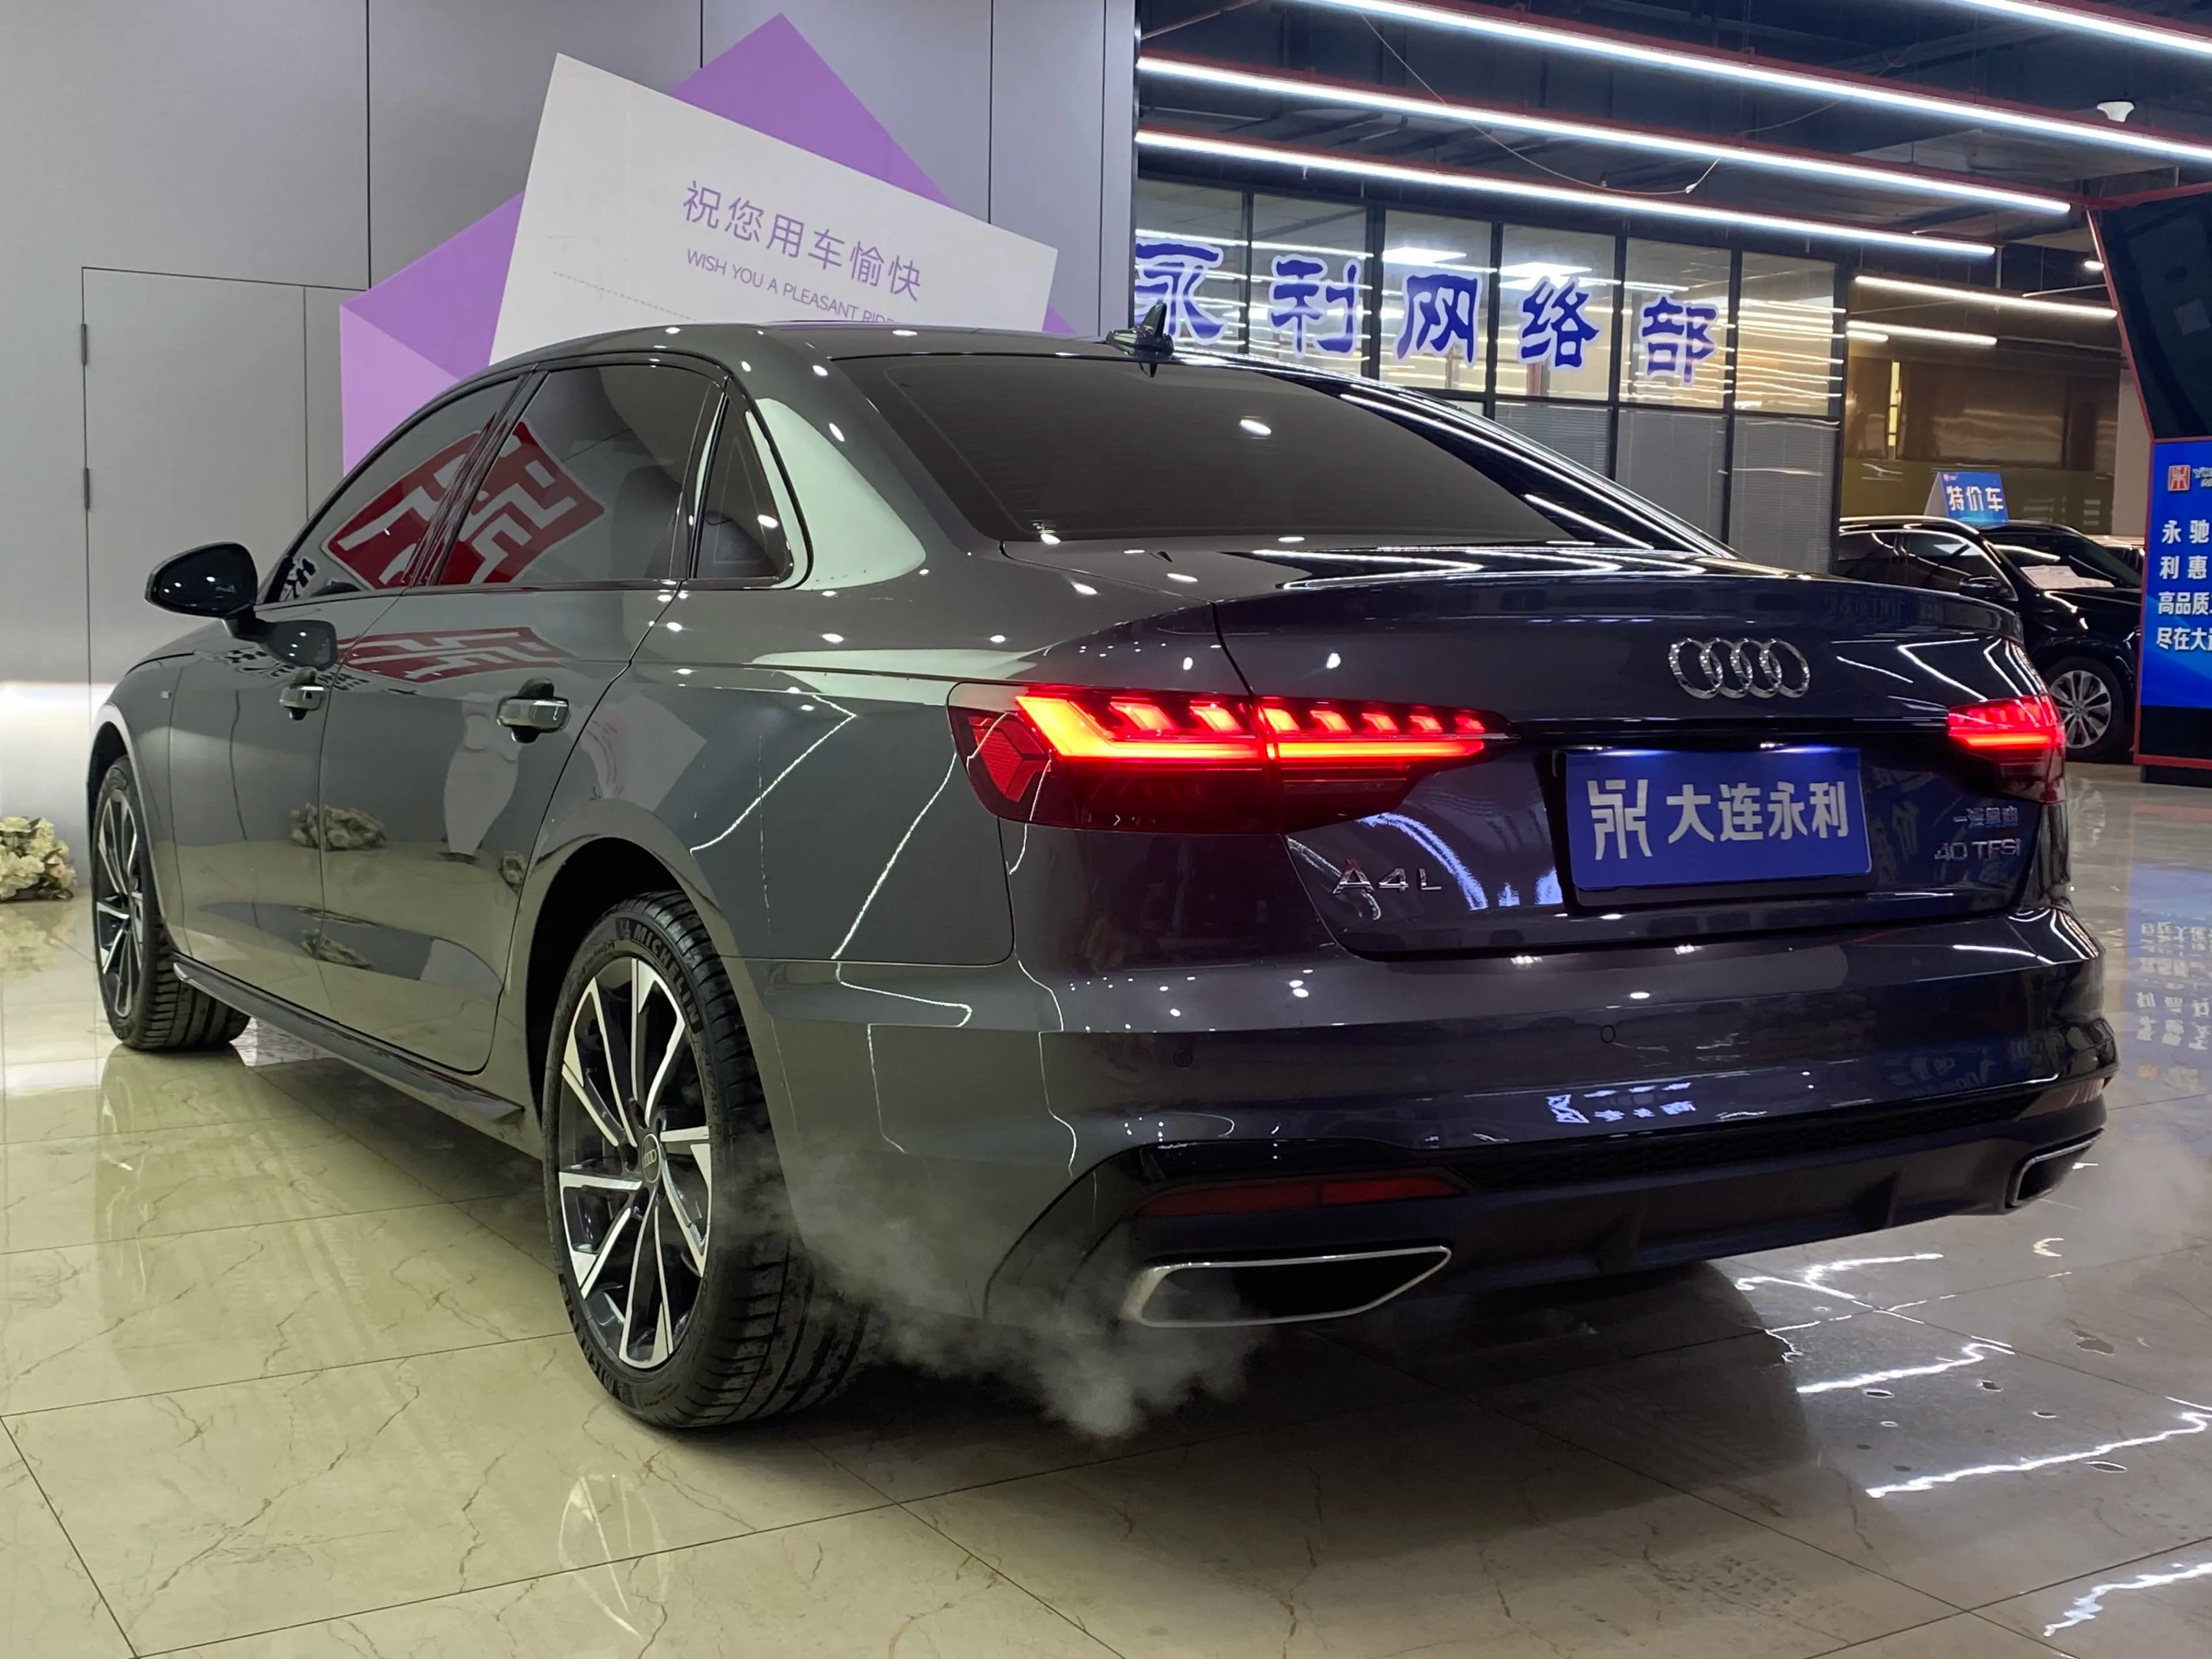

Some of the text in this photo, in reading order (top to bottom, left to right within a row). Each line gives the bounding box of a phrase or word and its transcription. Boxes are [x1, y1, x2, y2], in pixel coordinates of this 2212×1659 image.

[683, 180, 922, 302] 祝您用车愉快
[687, 248, 894, 323] WISH YOU A PLEASANT RID
[1946, 485, 2004, 512] 特价车
[2158, 591, 2212, 615] 高品质
[1666, 781, 1849, 844] 大连永利
[1971, 838, 2021, 859] TFSI
[632, 923, 700, 1025] MICHELIN
